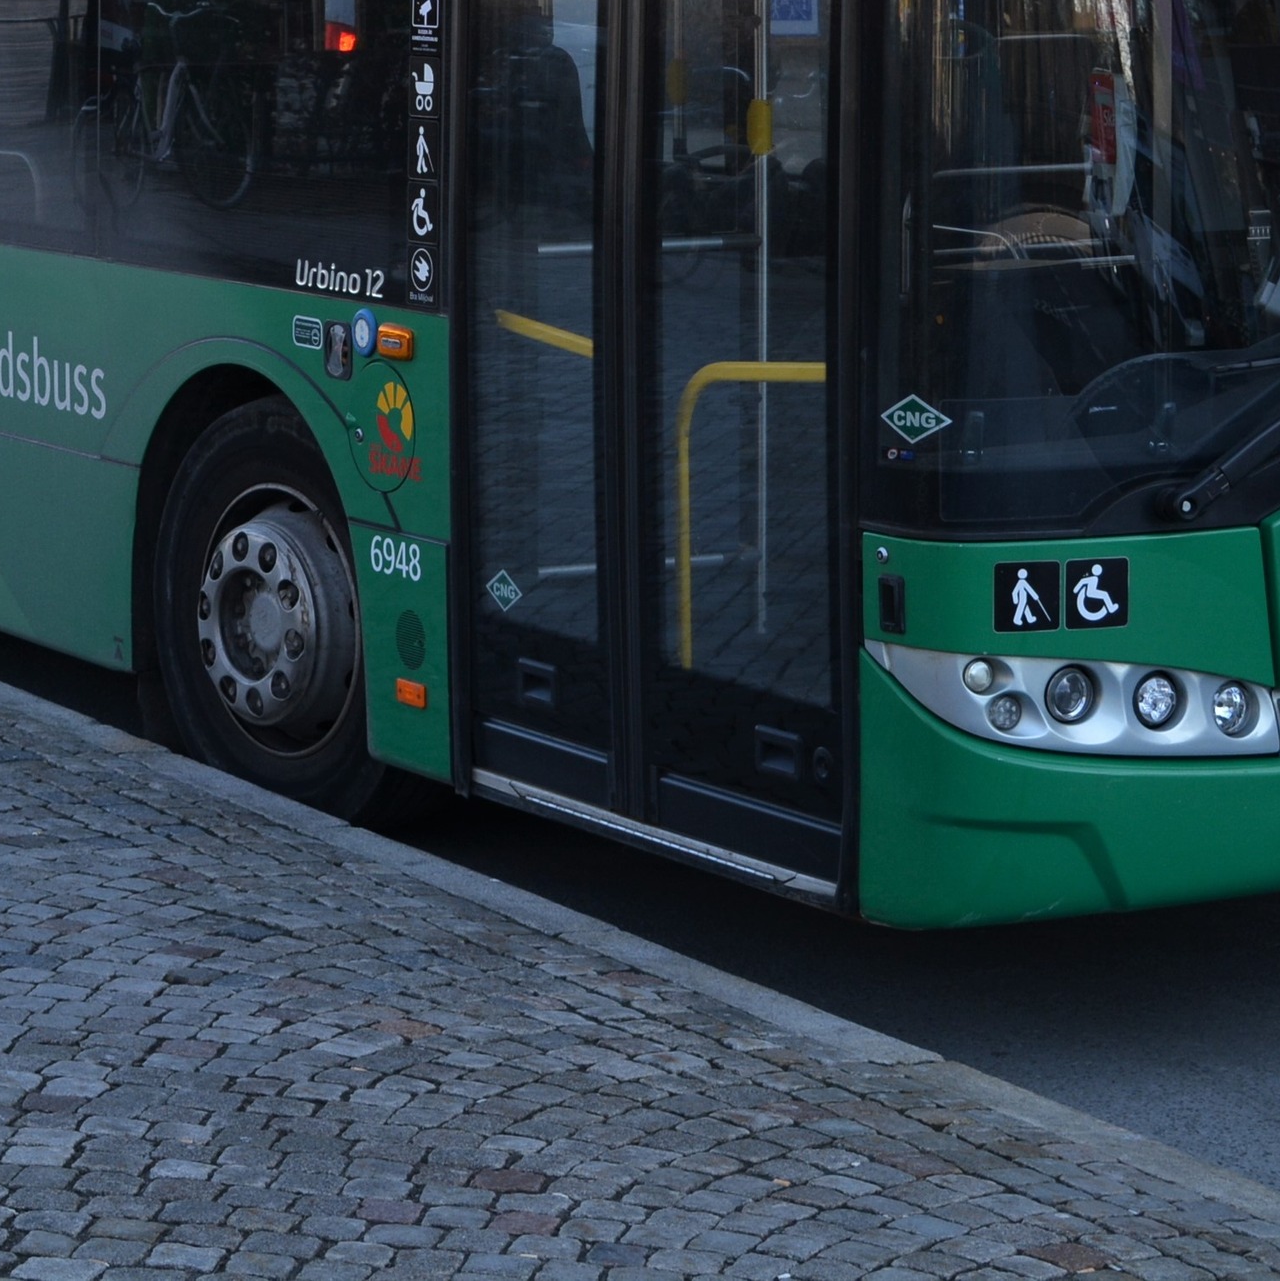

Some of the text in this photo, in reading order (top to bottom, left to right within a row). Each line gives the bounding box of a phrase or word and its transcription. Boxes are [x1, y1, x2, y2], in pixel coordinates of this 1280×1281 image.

[295, 258, 384, 298] Urbino 12
[893, 410, 936, 428] CNG
[370, 534, 421, 582] 6948
[493, 581, 516, 599] CNG
